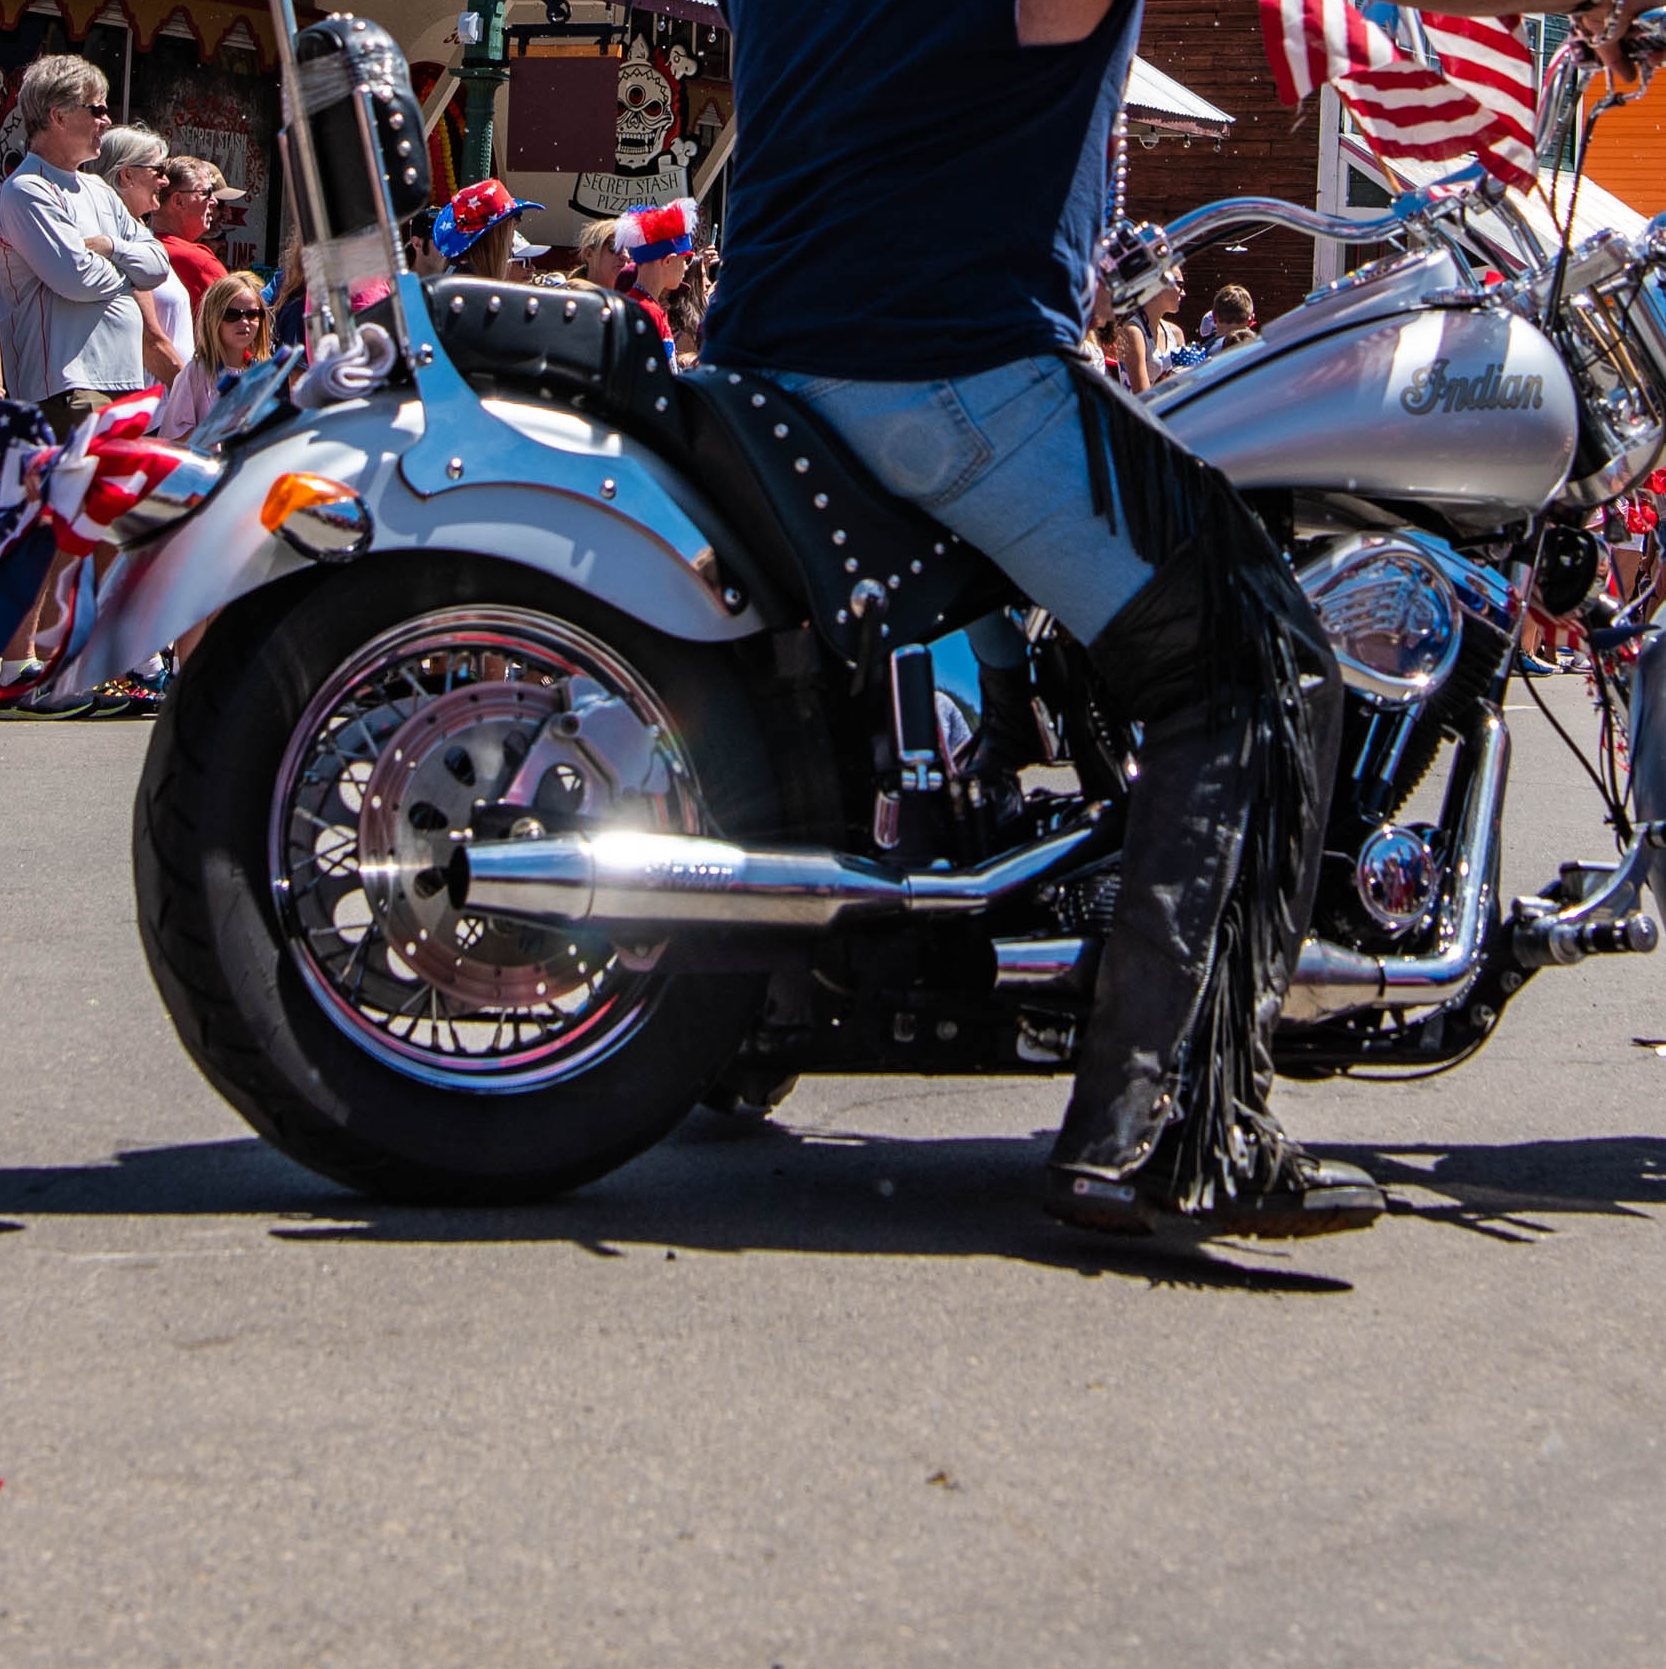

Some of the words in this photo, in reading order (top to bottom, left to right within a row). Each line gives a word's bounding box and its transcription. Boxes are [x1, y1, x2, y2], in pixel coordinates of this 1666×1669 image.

[180, 125, 215, 147] SECRET
[218, 131, 248, 154] STASH
[583, 171, 631, 196] SECRET
[636, 171, 679, 195] STASH
[1400, 358, 1544, 416] Indian
